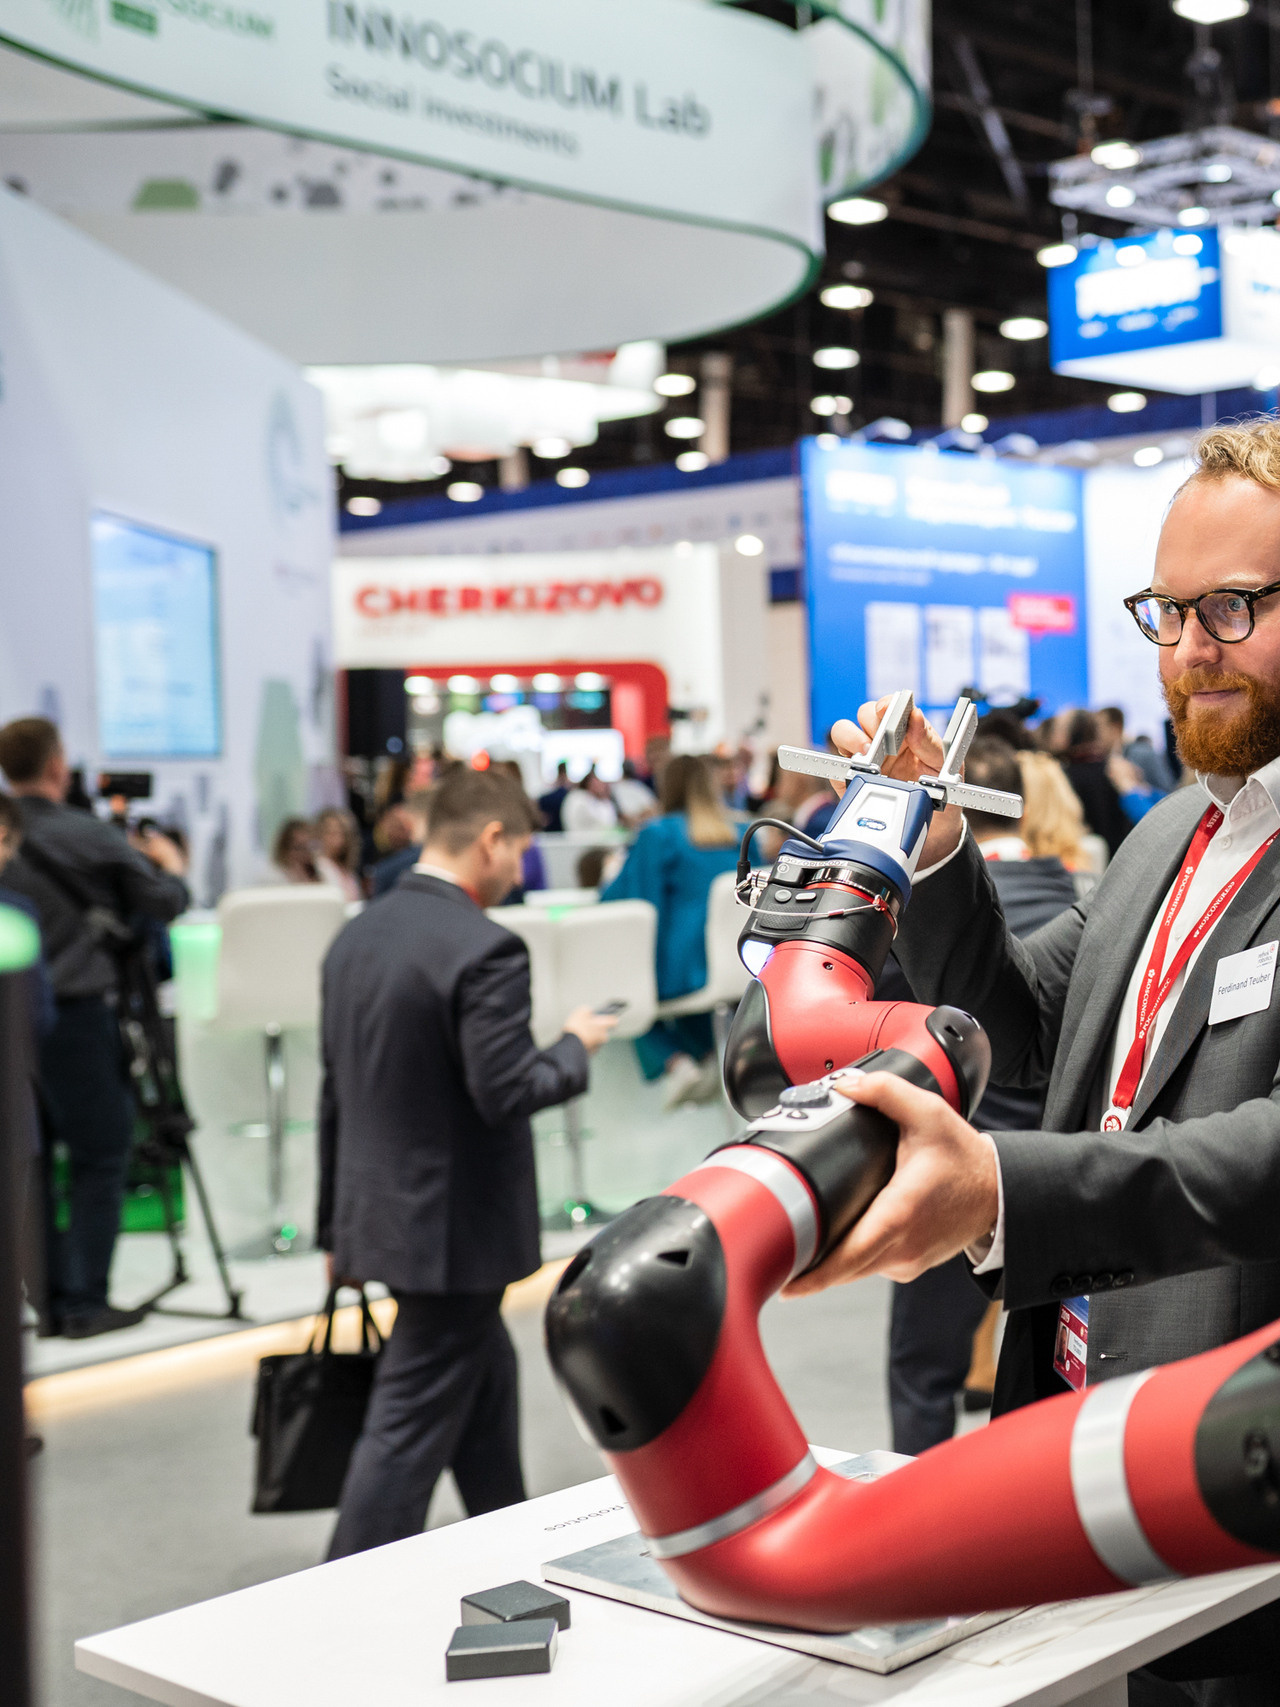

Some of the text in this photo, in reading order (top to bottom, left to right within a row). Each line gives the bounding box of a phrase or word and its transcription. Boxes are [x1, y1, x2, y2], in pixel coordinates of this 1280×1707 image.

[325, 0, 712, 138] INNOSOCIUM Lab
[326, 62, 578, 154] Social investments
[354, 574, 664, 619] CHERKIZOVO
[1217, 973, 1271, 996] Ferdinand Teuber
